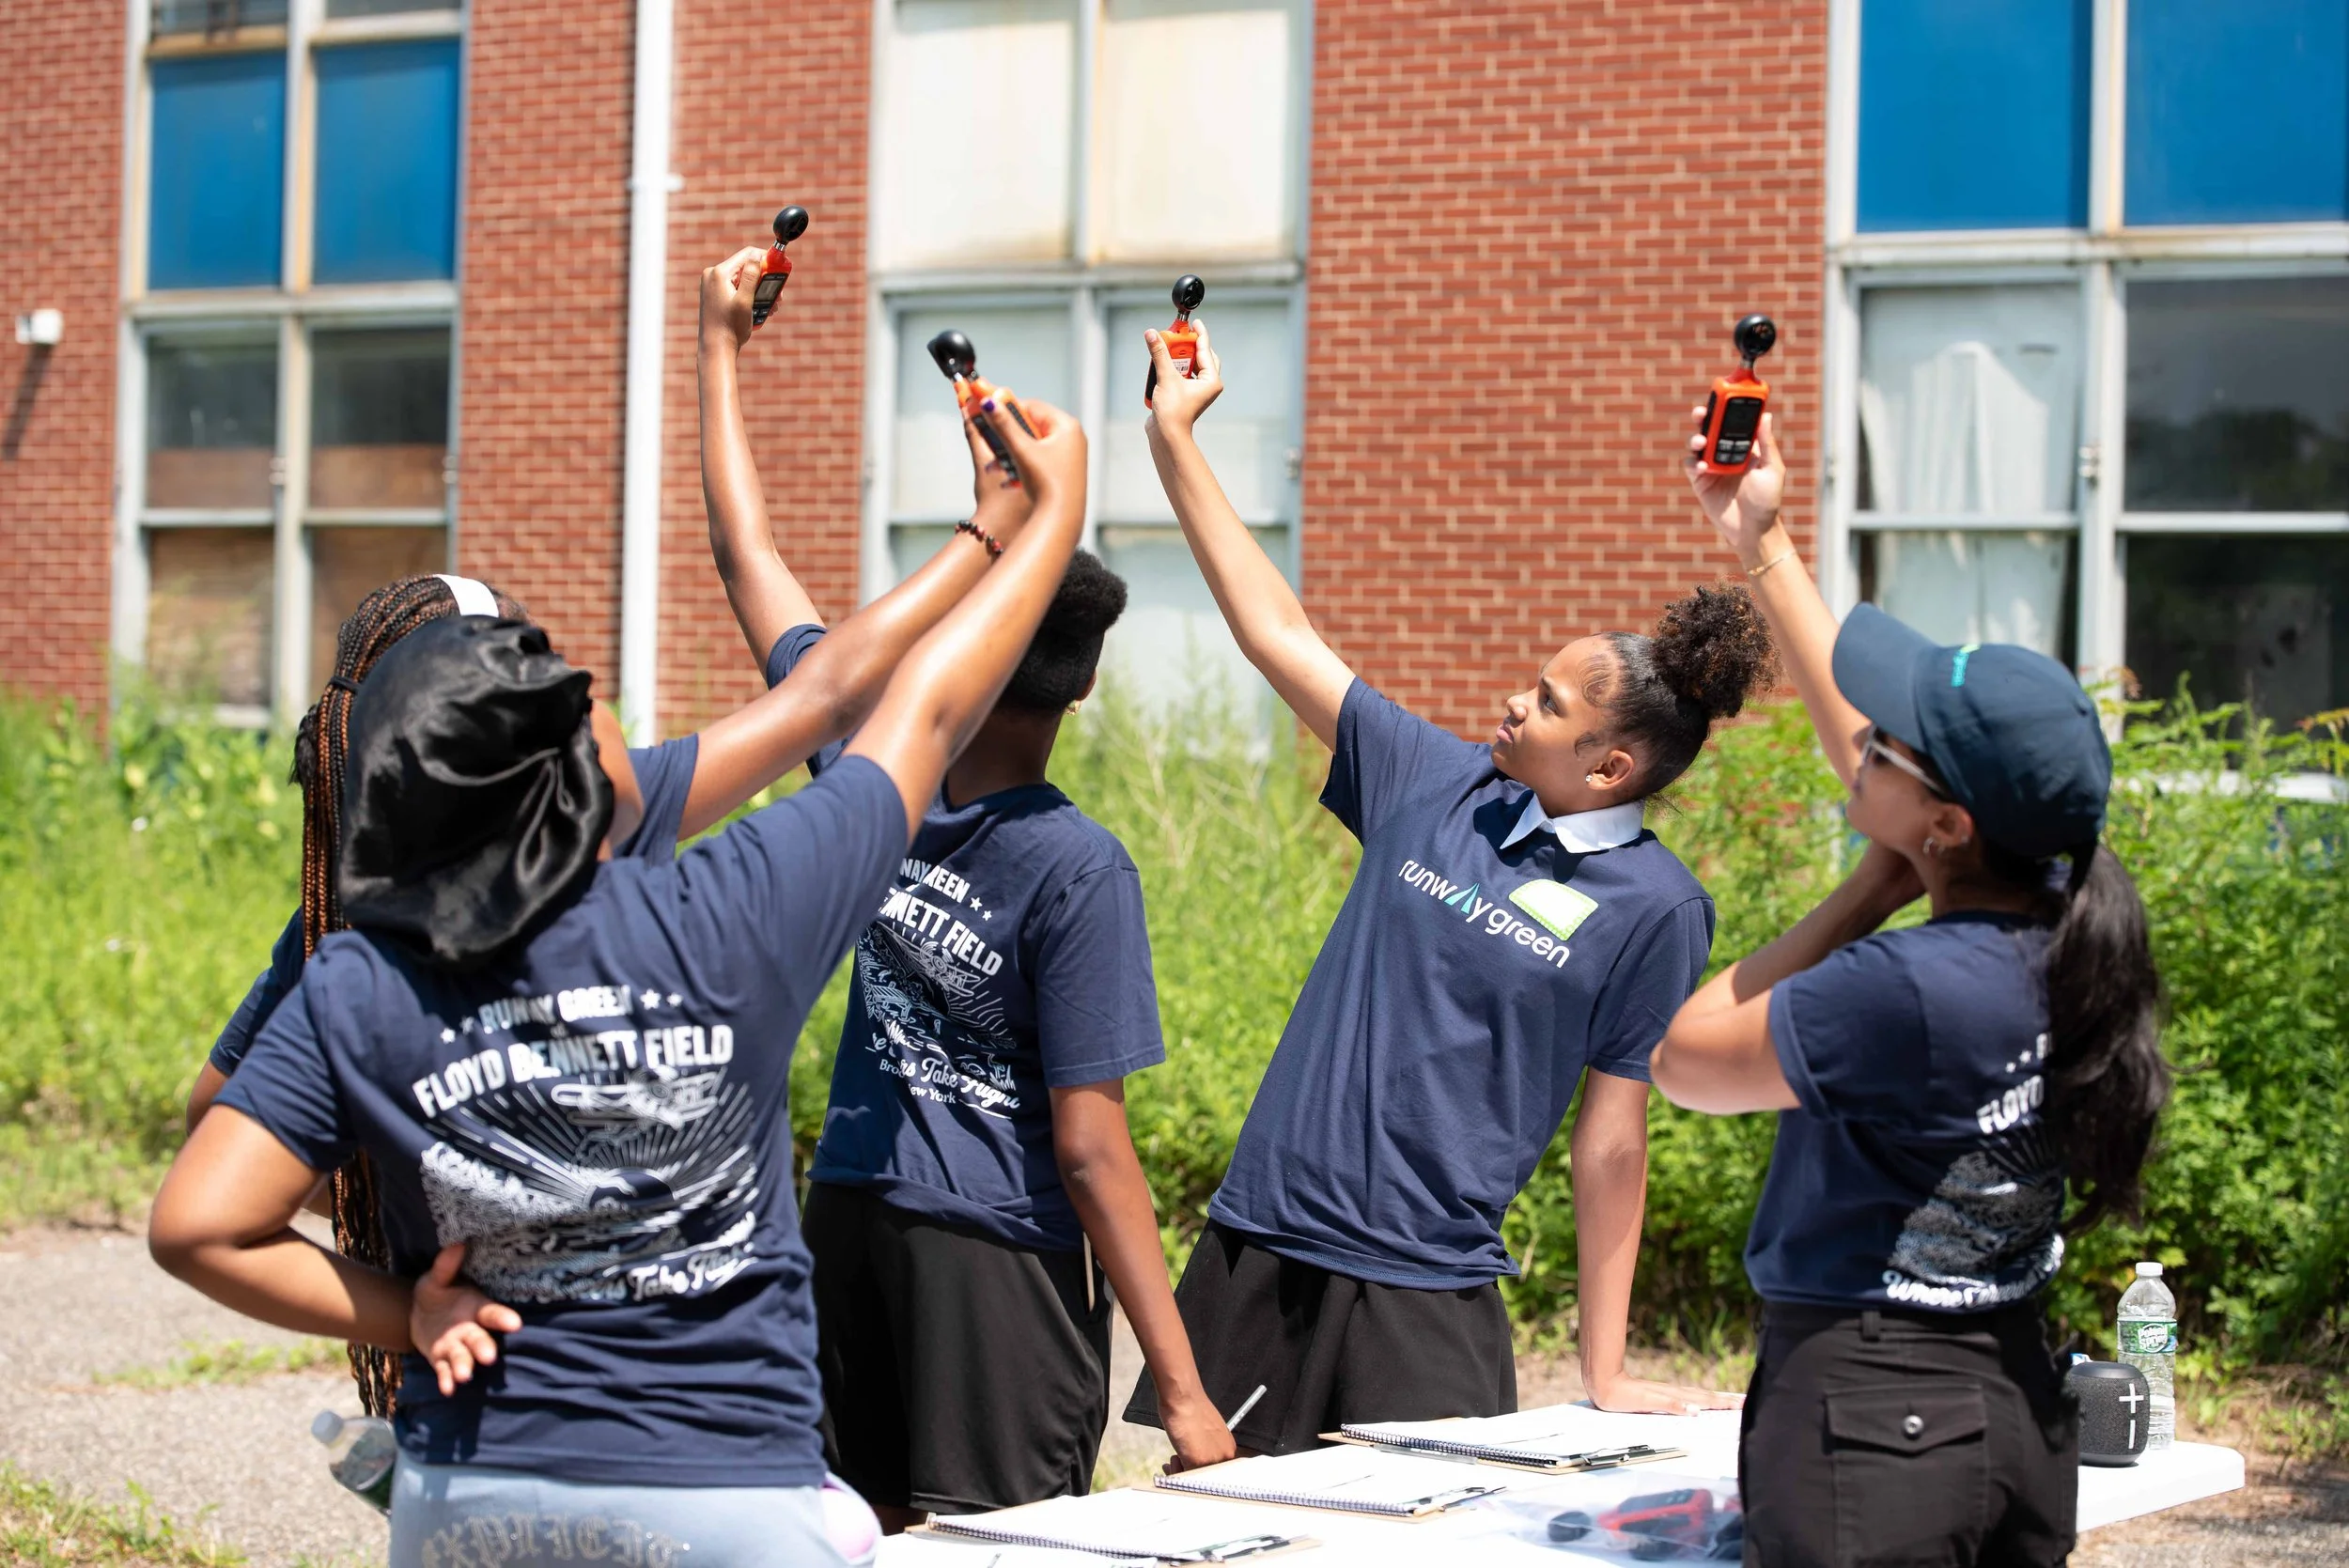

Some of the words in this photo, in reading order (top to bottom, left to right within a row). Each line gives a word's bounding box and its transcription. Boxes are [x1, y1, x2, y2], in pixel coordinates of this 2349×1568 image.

[941, 920, 1003, 976] FIELD
[412, 1048, 506, 1118] FLOYD
[644, 1024, 734, 1068] FIELD
[921, 1057, 958, 1088] Take
[927, 1087, 957, 1104] York
